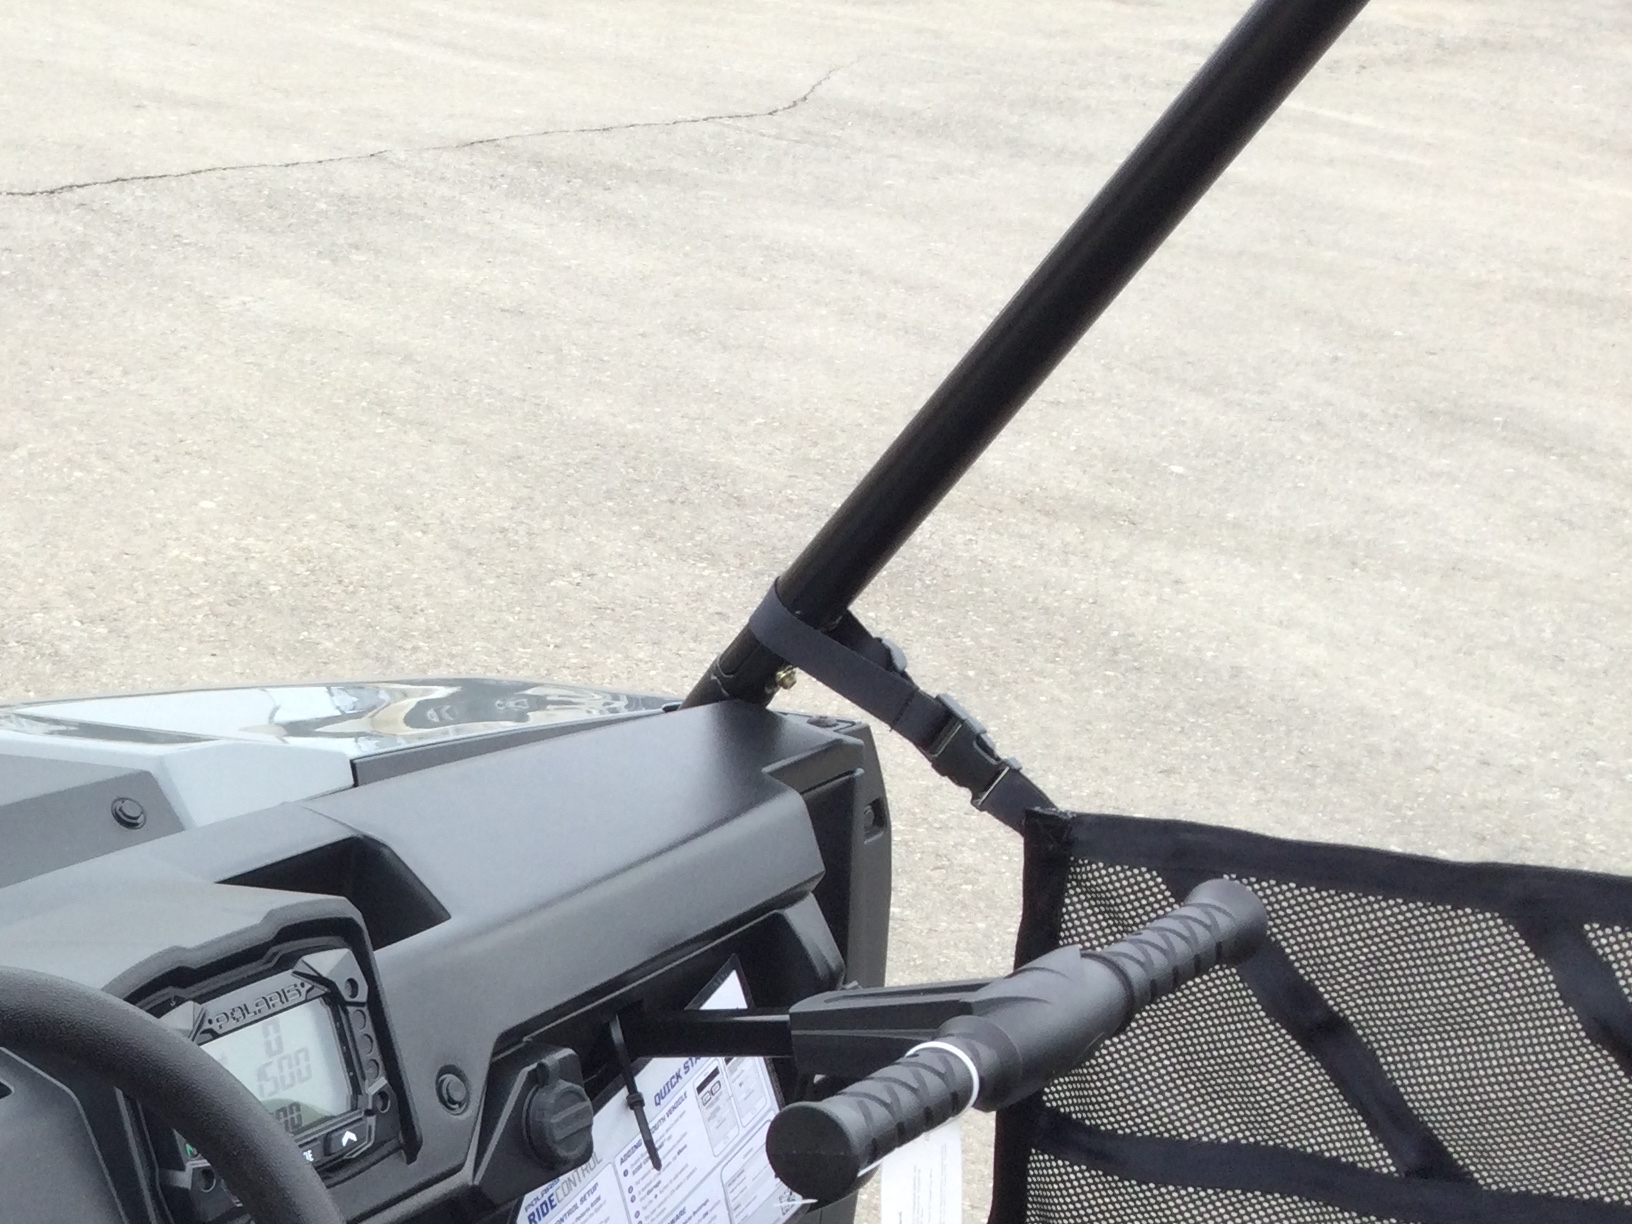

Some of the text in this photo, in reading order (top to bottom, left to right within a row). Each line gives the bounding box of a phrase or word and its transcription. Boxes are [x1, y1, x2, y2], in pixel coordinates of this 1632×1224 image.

[216, 984, 303, 1029] POLARIS
[653, 1072, 683, 1107] QUICK
[579, 1182, 599, 1205] SETUP
